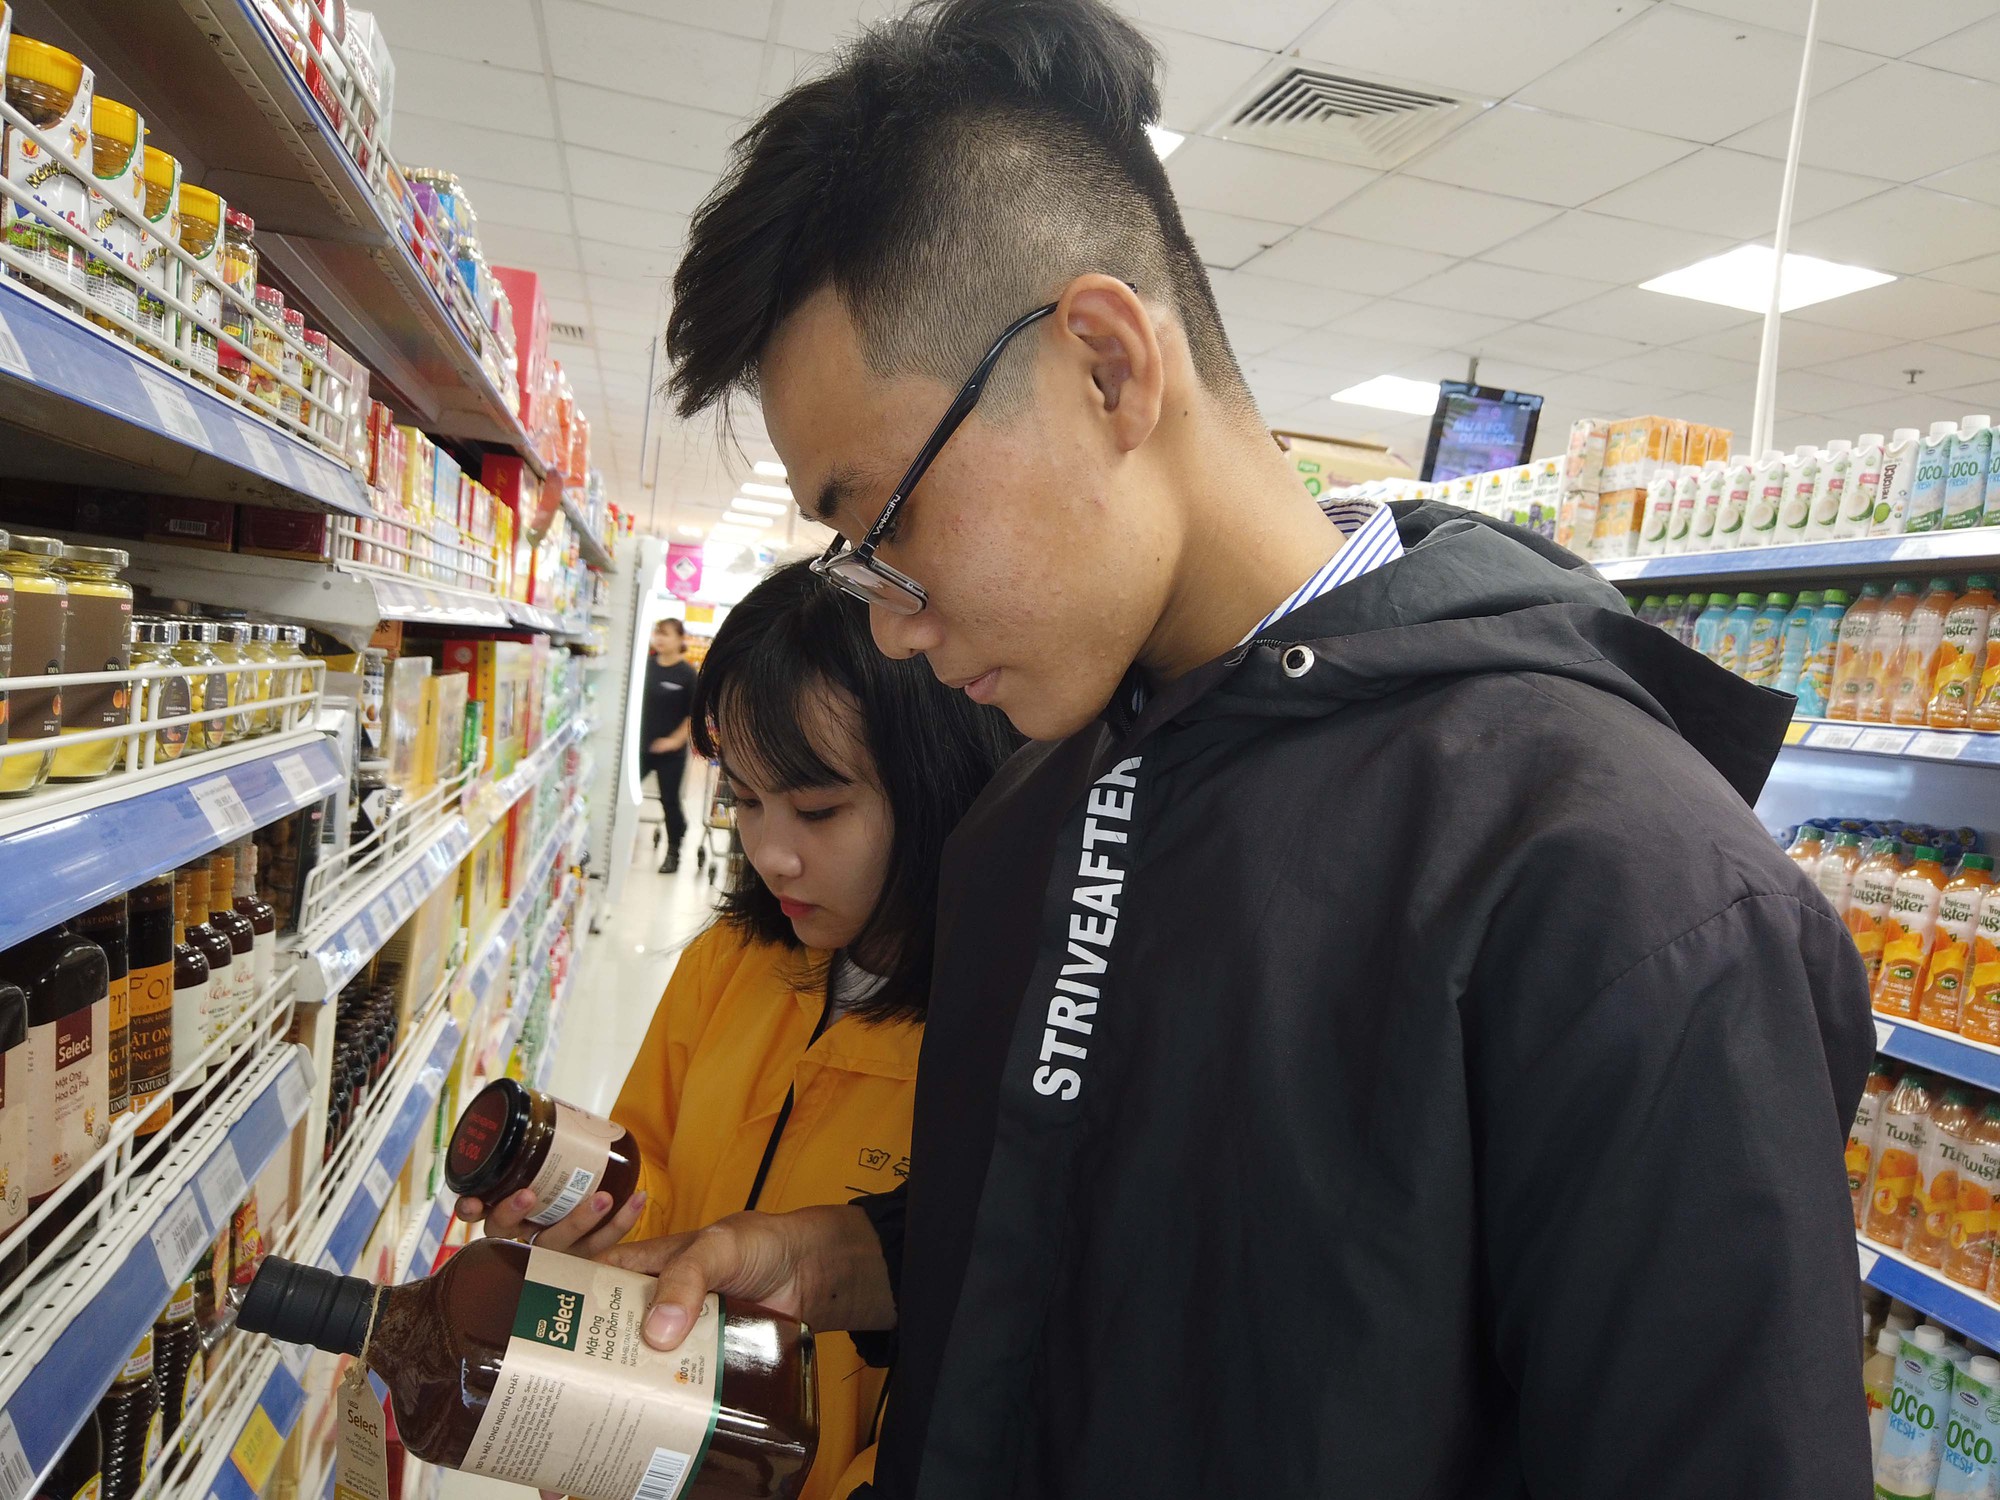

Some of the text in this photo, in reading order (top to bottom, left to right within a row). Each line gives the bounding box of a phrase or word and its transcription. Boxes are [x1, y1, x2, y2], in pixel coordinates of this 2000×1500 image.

[872, 494, 902, 535] Velocity
[58, 1035, 91, 1063] Select
[537, 1320, 547, 1337] COOP
[549, 1293, 576, 1345] Select
[585, 1315, 605, 1357] Mật Ong
[601, 1286, 623, 1361] Hoa Chôm Chôm
[620, 1310, 635, 1365] RAMBUTAN FLOWER
[630, 1341, 640, 1367] NATURAL
[680, 1366, 688, 1380] 100
[347, 1409, 379, 1438] Select
[489, 1424, 500, 1441] ONG
[495, 1396, 512, 1426] NGUYÊN
[507, 1373, 520, 1395] CHẤT
[1890, 1387, 1935, 1430] OCO
[1946, 1419, 1993, 1465] OCO
